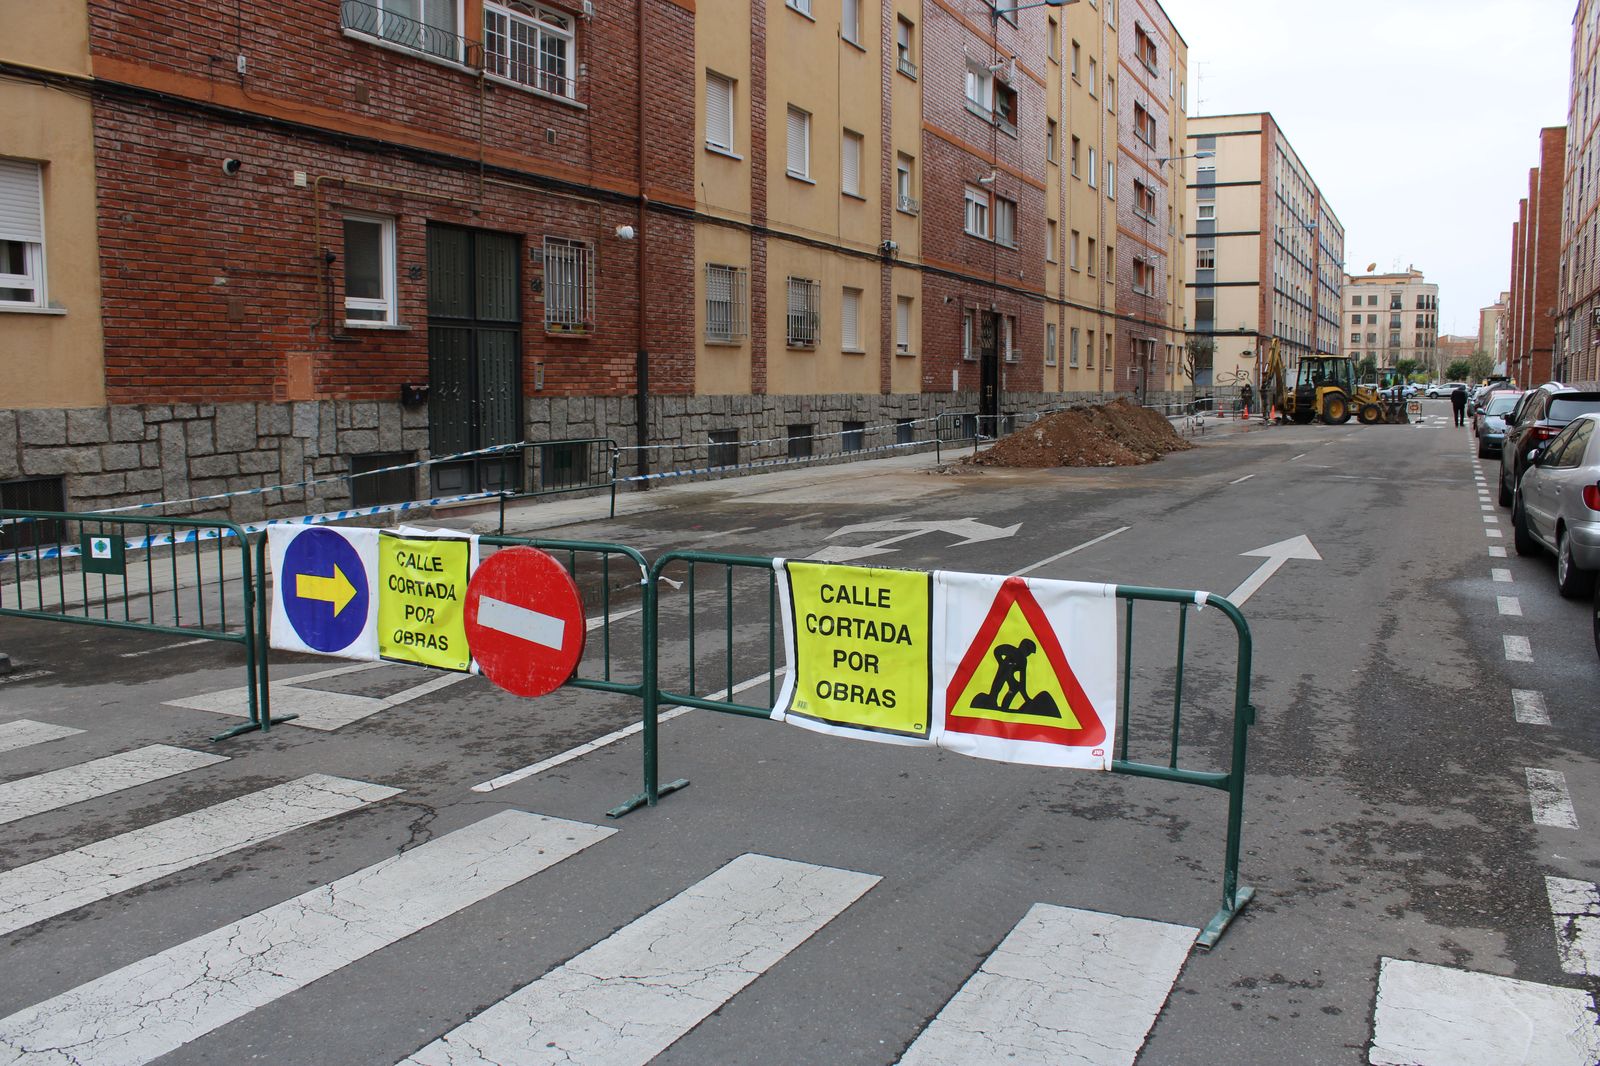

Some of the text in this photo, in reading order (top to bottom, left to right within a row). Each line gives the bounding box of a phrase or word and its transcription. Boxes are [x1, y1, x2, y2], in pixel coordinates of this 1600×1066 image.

[396, 551, 443, 572] CALLE
[388, 574, 457, 601] CORTADA
[820, 583, 891, 609] CALLE
[405, 604, 435, 625] POR
[393, 628, 449, 651] OBRAS
[805, 613, 913, 646] CORTADA
[833, 649, 879, 674] POR
[816, 680, 896, 709] OBRAS
